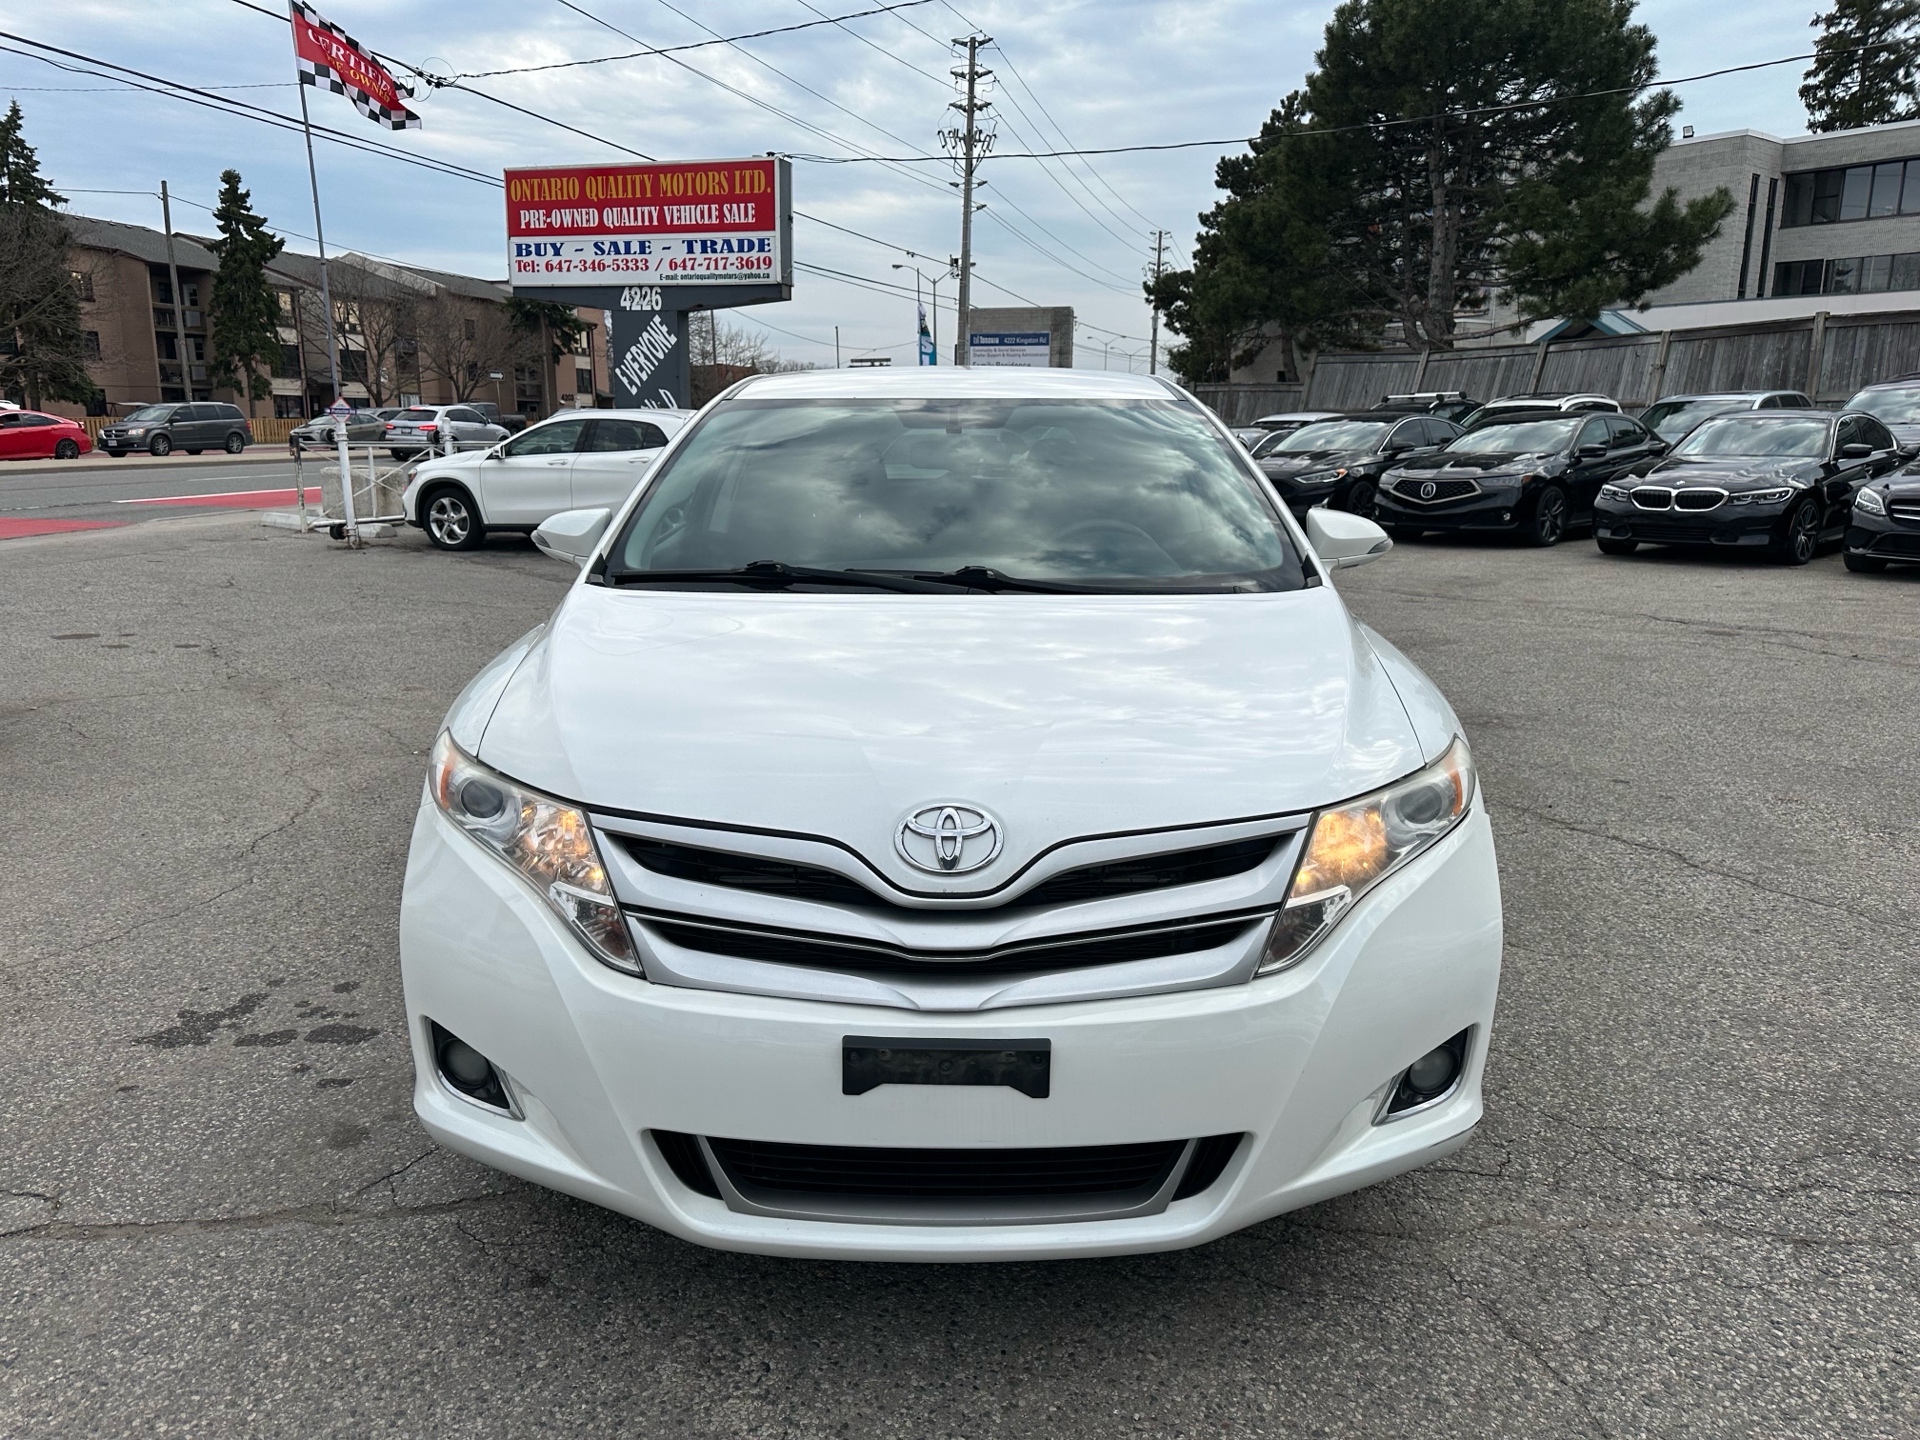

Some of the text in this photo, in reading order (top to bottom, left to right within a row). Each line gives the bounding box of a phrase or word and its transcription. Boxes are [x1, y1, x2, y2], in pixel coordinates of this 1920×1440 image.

[510, 169, 771, 202] ONTARIO QUALITY MOTORS LTD.
[520, 203, 756, 229] PRE-OWNED QUALITY VEHICLE SALE
[515, 242, 565, 257] BUY
[593, 240, 652, 256] SALE
[682, 238, 772, 254] TRADE
[515, 259, 540, 273] Tel:
[545, 257, 649, 272] 647-346-5333
[668, 256, 773, 271] 647-717-3619
[659, 272, 770, 281] E-mail: ontarioqualitymotors@yahoo.ca
[620, 286, 662, 311] 4226
[1016, 337, 1039, 345] Kingston
[614, 314, 678, 396] EVERYONE
